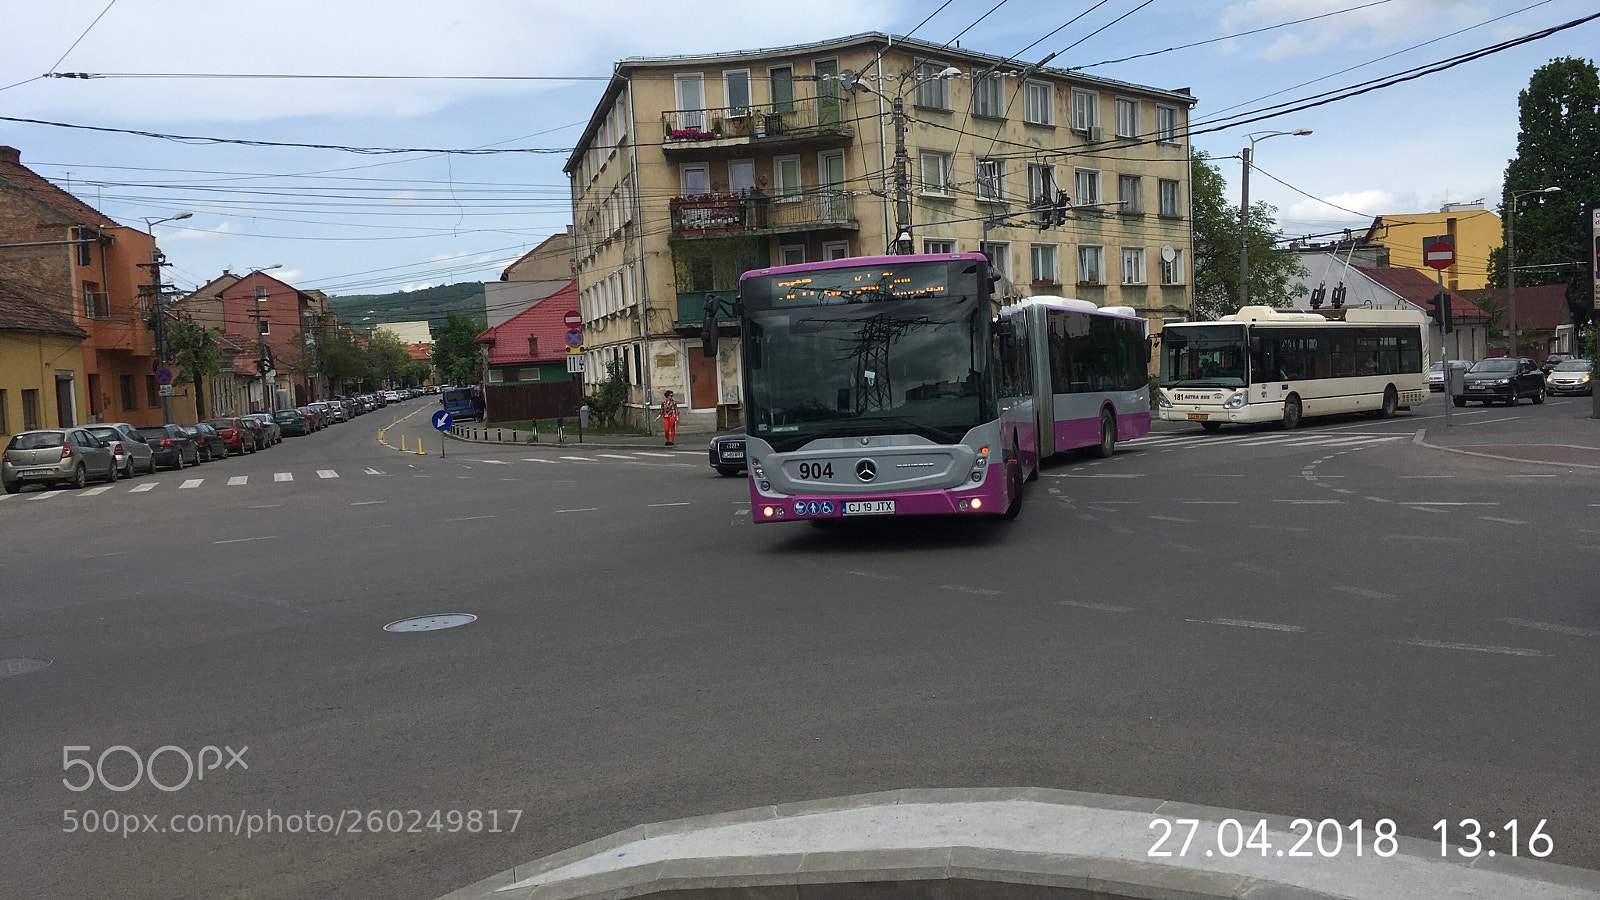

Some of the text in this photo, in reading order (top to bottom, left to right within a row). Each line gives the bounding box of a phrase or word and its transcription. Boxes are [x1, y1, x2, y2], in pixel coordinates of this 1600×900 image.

[800, 462, 834, 480] 904
[849, 501, 892, 512] CJ 19 JTX
